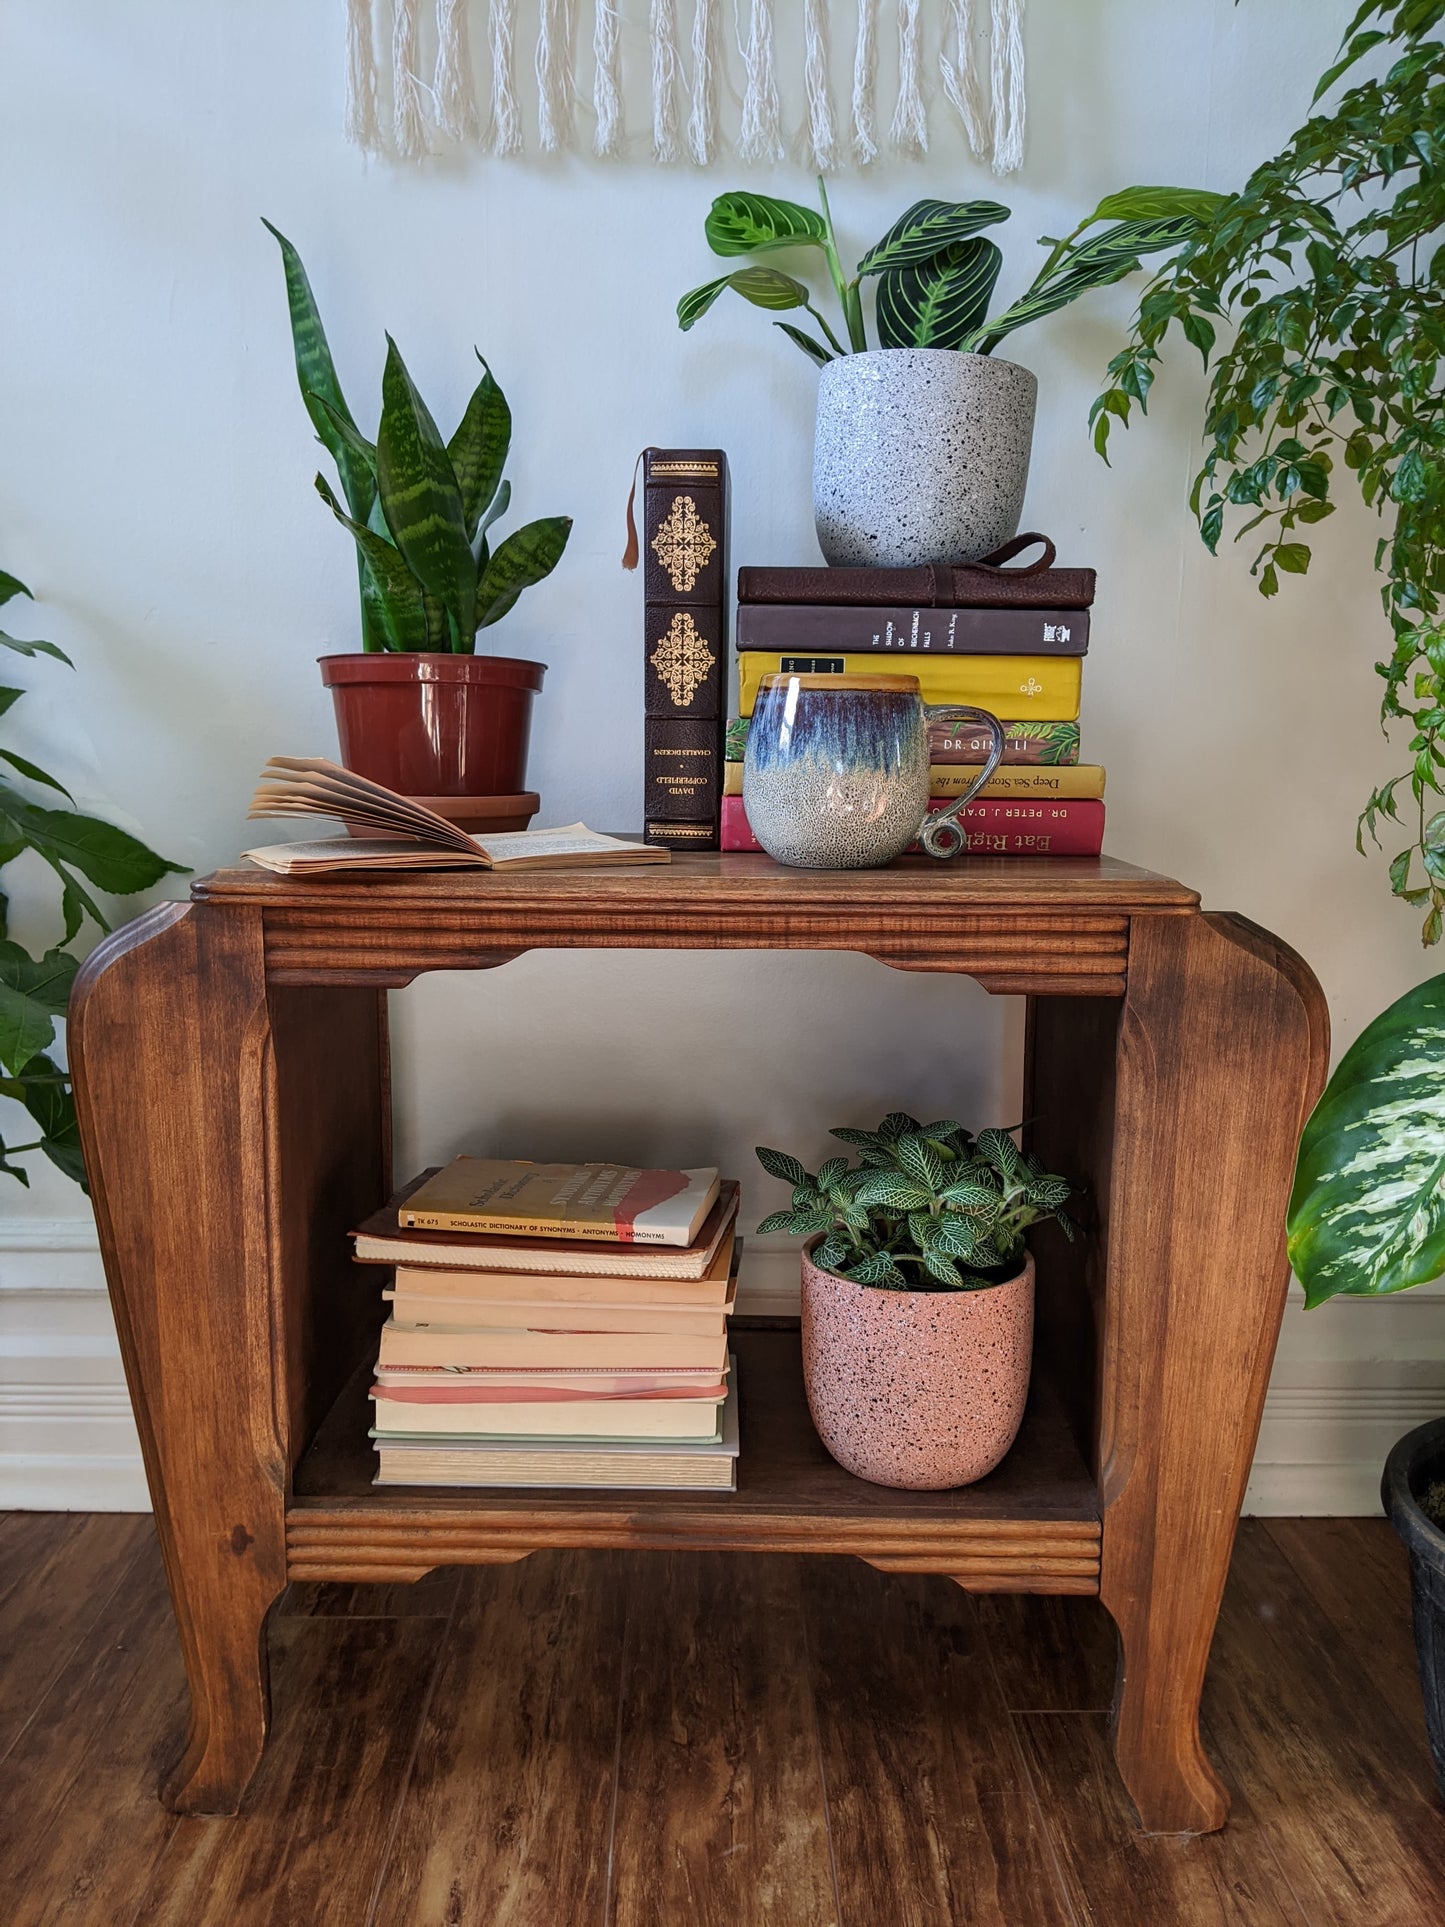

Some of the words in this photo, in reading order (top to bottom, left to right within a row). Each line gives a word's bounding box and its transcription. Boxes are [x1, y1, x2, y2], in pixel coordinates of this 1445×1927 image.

[885, 621, 893, 646] SHADOW
[923, 631, 931, 648] FALLS
[872, 634, 880, 646] THE
[898, 637, 905, 647] OF
[943, 739, 966, 750] DR.
[970, 739, 1007, 751] QIN
[1014, 740, 1027, 751] LI
[656, 776, 708, 785] COPPERFIELD
[935, 777, 951, 787] the
[952, 774, 979, 788] from
[985, 777, 1012, 789] Stori
[1014, 777, 1031, 789] Sea
[1033, 777, 1060, 789] Deep
[669, 787, 695, 795] DAVID
[991, 808, 1001, 817] J.
[1005, 808, 1043, 818] PETER
[1048, 808, 1067, 818] DR.
[963, 832, 1009, 850] Righ
[1015, 834, 1052, 850] Eat
[417, 1217, 425, 1225] TK
[450, 1220, 487, 1229] SCHOLASTIC
[489, 1222, 527, 1231] DICTIONARY
[540, 1225, 576, 1234] SYNONYMS
[582, 1228, 619, 1237] ANTONYMS
[625, 1231, 665, 1240] HOMONYMS
